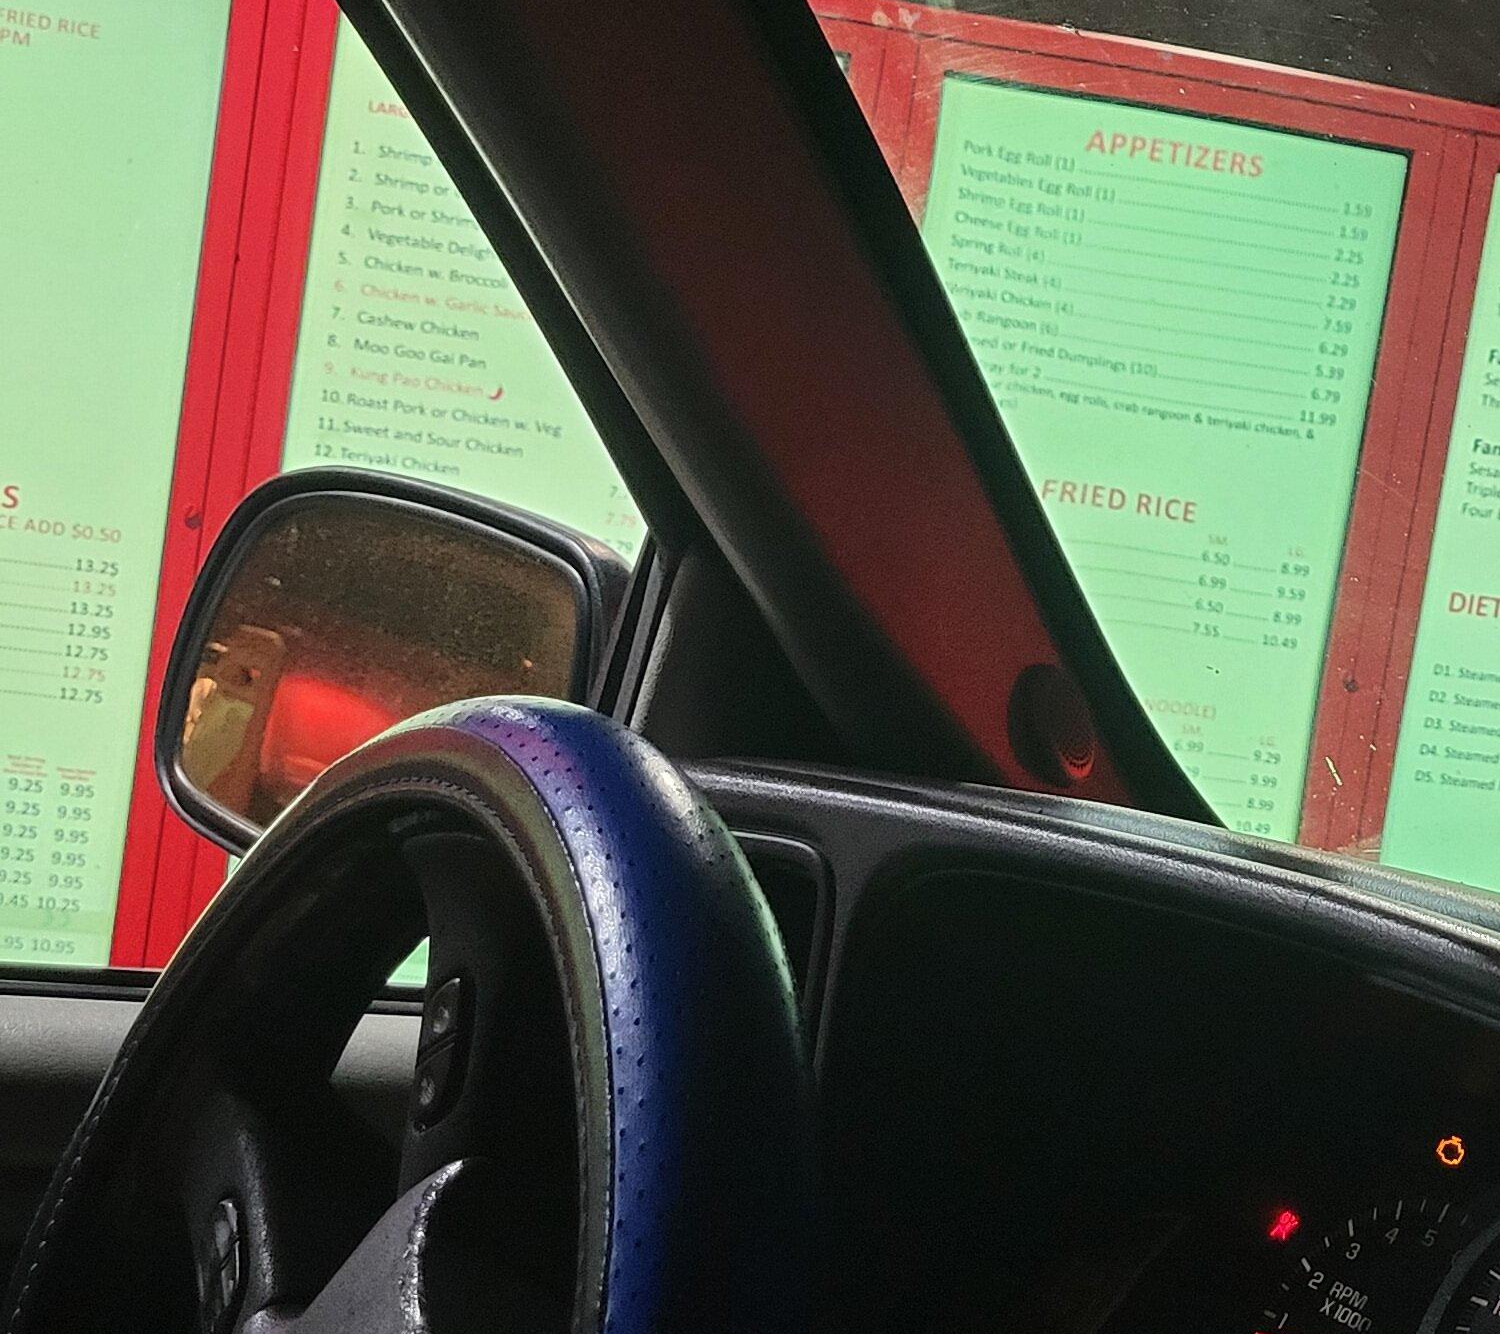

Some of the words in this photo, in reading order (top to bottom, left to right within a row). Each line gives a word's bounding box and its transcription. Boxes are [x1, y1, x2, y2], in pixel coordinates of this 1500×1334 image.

[58, 17, 101, 40] RICE
[1085, 129, 1264, 178] APPETIZERS
[356, 310, 415, 331] Cashew
[419, 320, 480, 341] Chicken
[353, 337, 390, 355] Moo
[393, 344, 426, 361] Goo
[429, 349, 455, 365] Gai
[458, 353, 487, 370] Pan
[1310, 387, 1341, 404] 6.79
[1299, 409, 1337, 427] 11.99
[343, 420, 390, 439] Sweet
[393, 430, 423, 444] and
[426, 431, 462, 449] Sour
[464, 437, 524, 458] Chicken
[1041, 478, 1127, 511] FRIED
[1136, 492, 1198, 524] RICE
[24, 517, 66, 537] ADD
[71, 522, 122, 544] $0.50
[75, 558, 119, 578] 13.25
[69, 601, 114, 619] 13.25
[66, 623, 112, 641] 12.95
[64, 644, 109, 663] 12.75
[61, 665, 107, 684] 12.75
[59, 687, 104, 705] 12.75
[8, 776, 44, 795] 9.25
[59, 782, 95, 800] 9.95
[5, 800, 41, 817] 9.25
[56, 805, 92, 822] 9.95
[2, 823, 38, 840] 9.25
[54, 828, 89, 845] 9.95
[0, 846, 35, 863] 9.25
[51, 851, 86, 868] 9.95
[49, 874, 84, 891] 9.95
[38, 896, 81, 913] 10.25
[32, 937, 76, 955] 10.95
[1345, 1242, 1361, 1261] 3
[1308, 1271, 1325, 1290] 2
[1329, 1281, 1369, 1310] RPM
